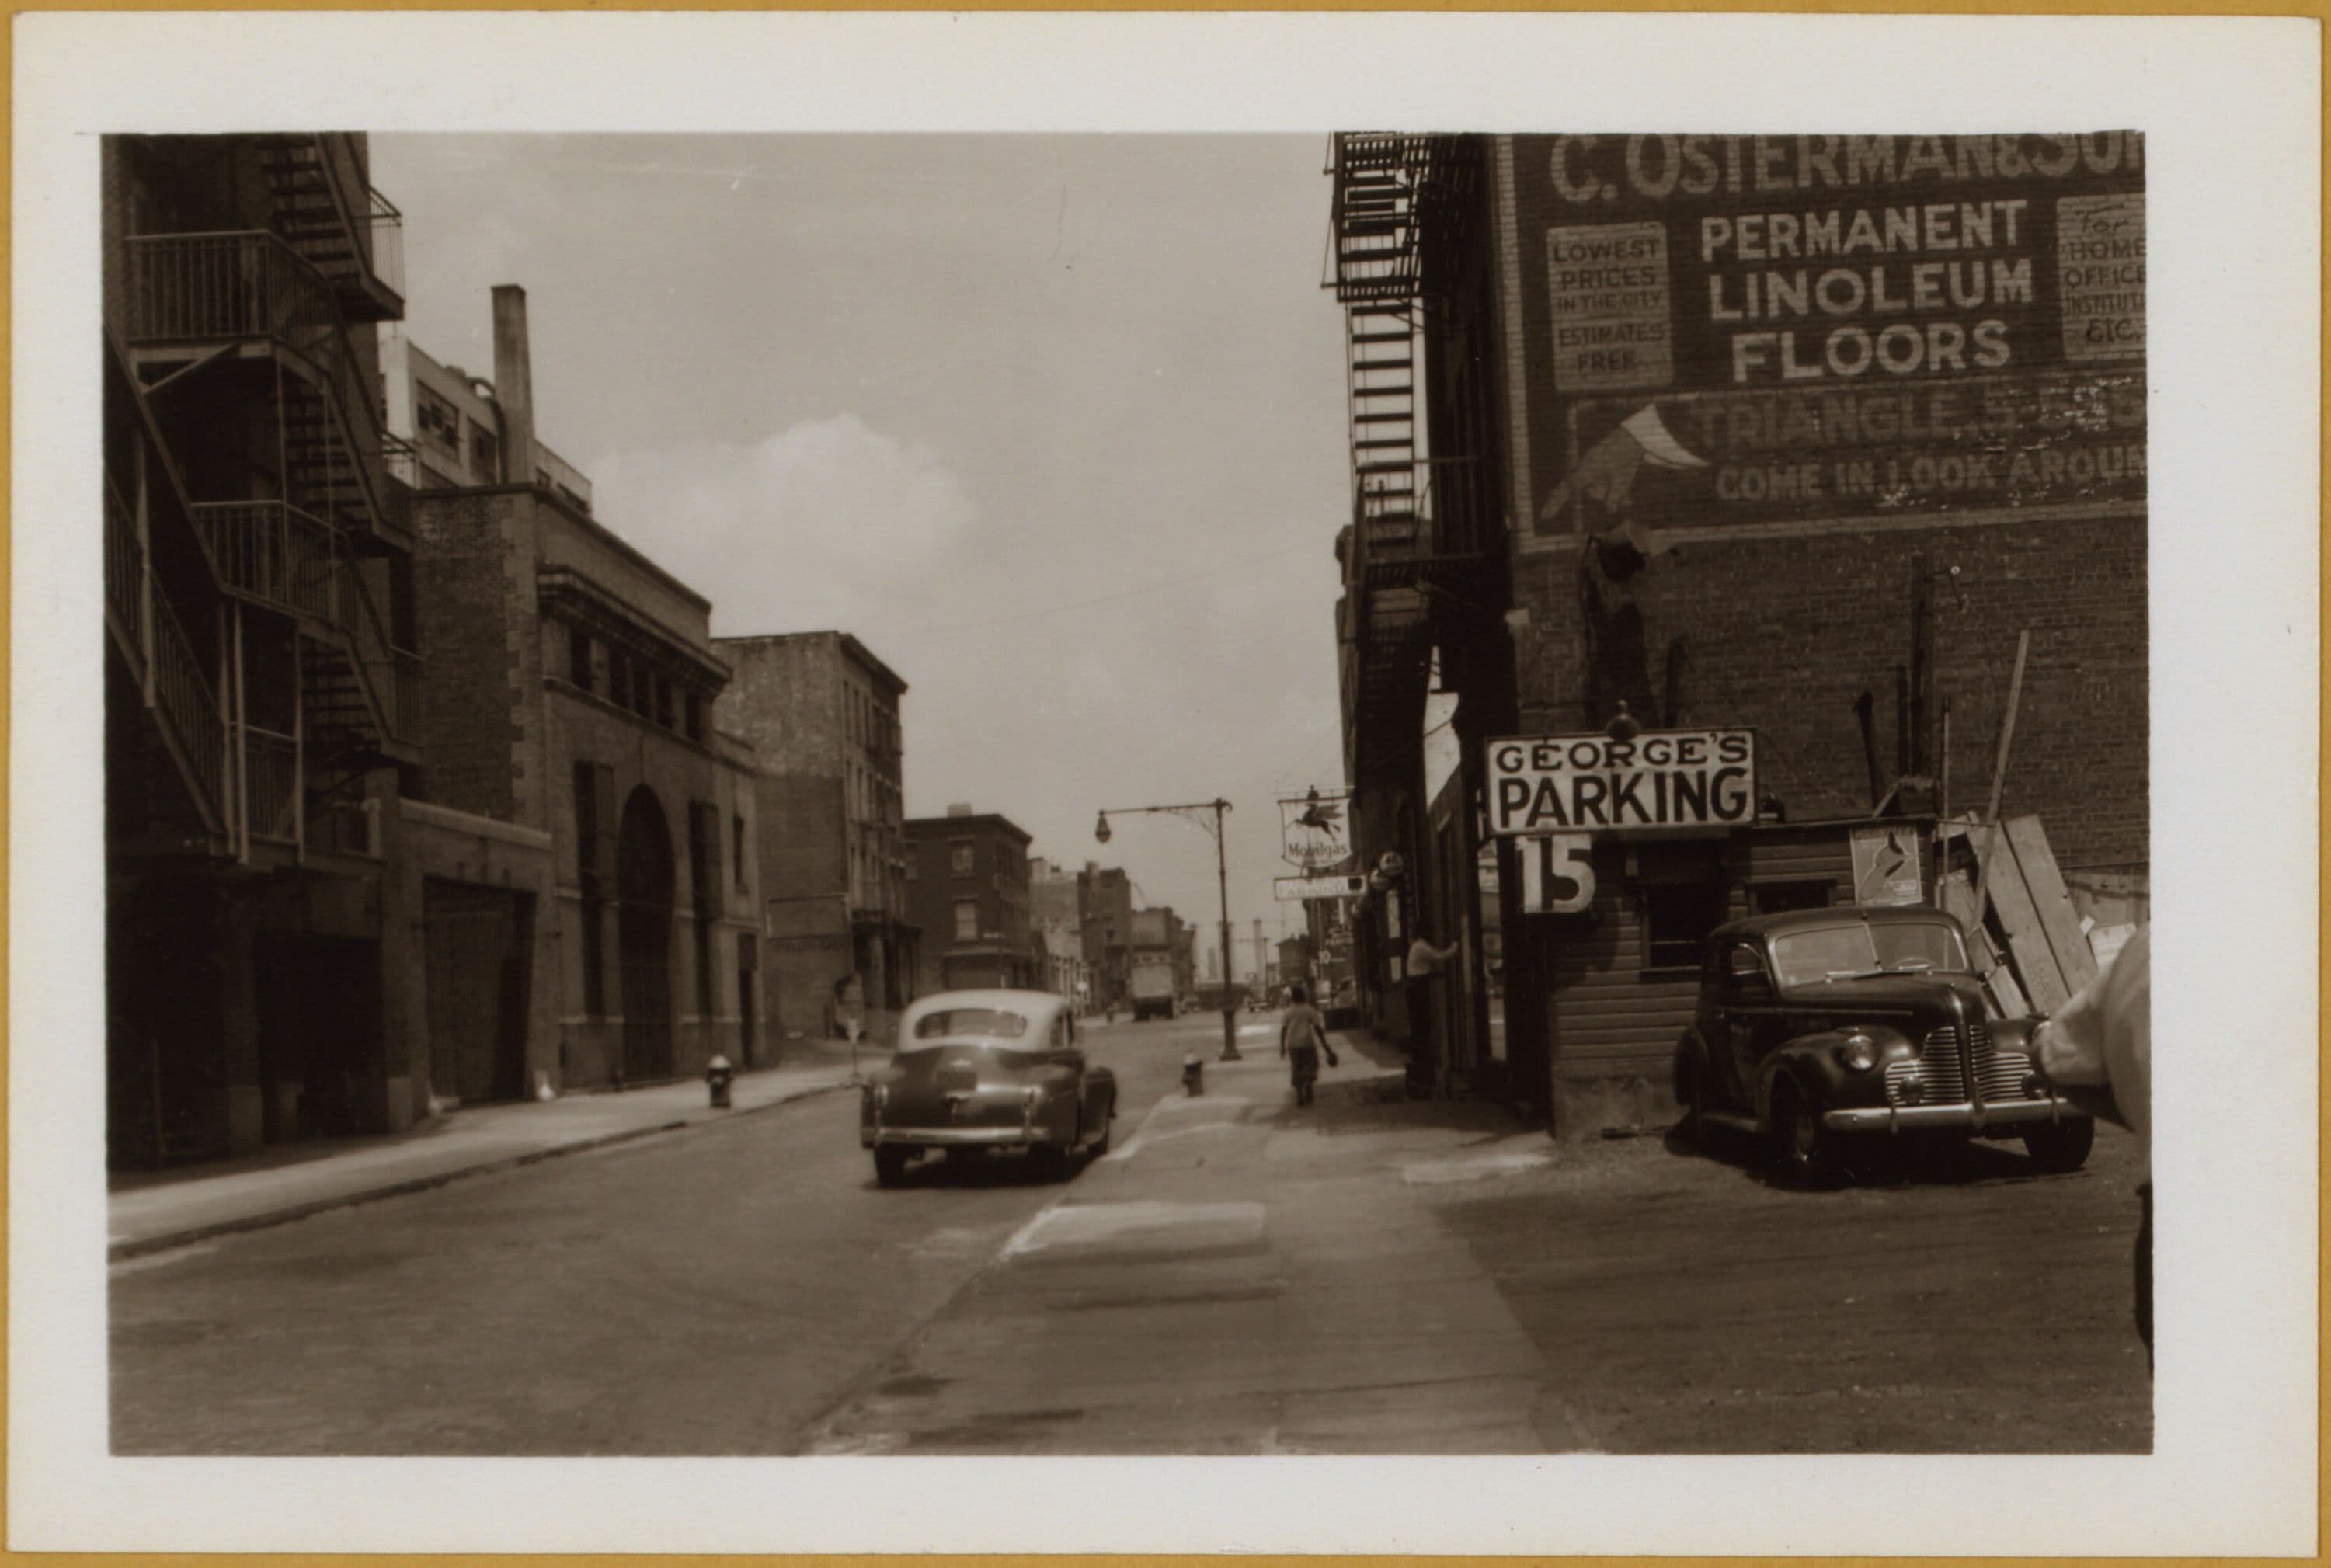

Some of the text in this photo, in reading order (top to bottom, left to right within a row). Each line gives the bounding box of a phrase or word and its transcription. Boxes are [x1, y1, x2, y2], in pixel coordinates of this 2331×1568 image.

[1552, 133, 1620, 201] C.
[1553, 239, 1660, 262] LOWEST
[1702, 200, 2028, 262] PERMANENT
[1557, 291, 1663, 311] IN THE CITY
[1560, 266, 1656, 290] PRICES
[1710, 258, 2032, 320] LINOLEUM
[1558, 323, 1664, 347] ESTIMATES
[1731, 319, 2012, 382] FLOORS
[1578, 350, 1636, 372] FREE
[1695, 393, 1958, 449] TRIANGLE
[1716, 464, 1823, 500] COME
[1835, 463, 1874, 495] IN
[1496, 735, 1749, 774] GEORGE'S
[1499, 767, 1748, 829] PARKING
[1514, 834, 1595, 913] 15
